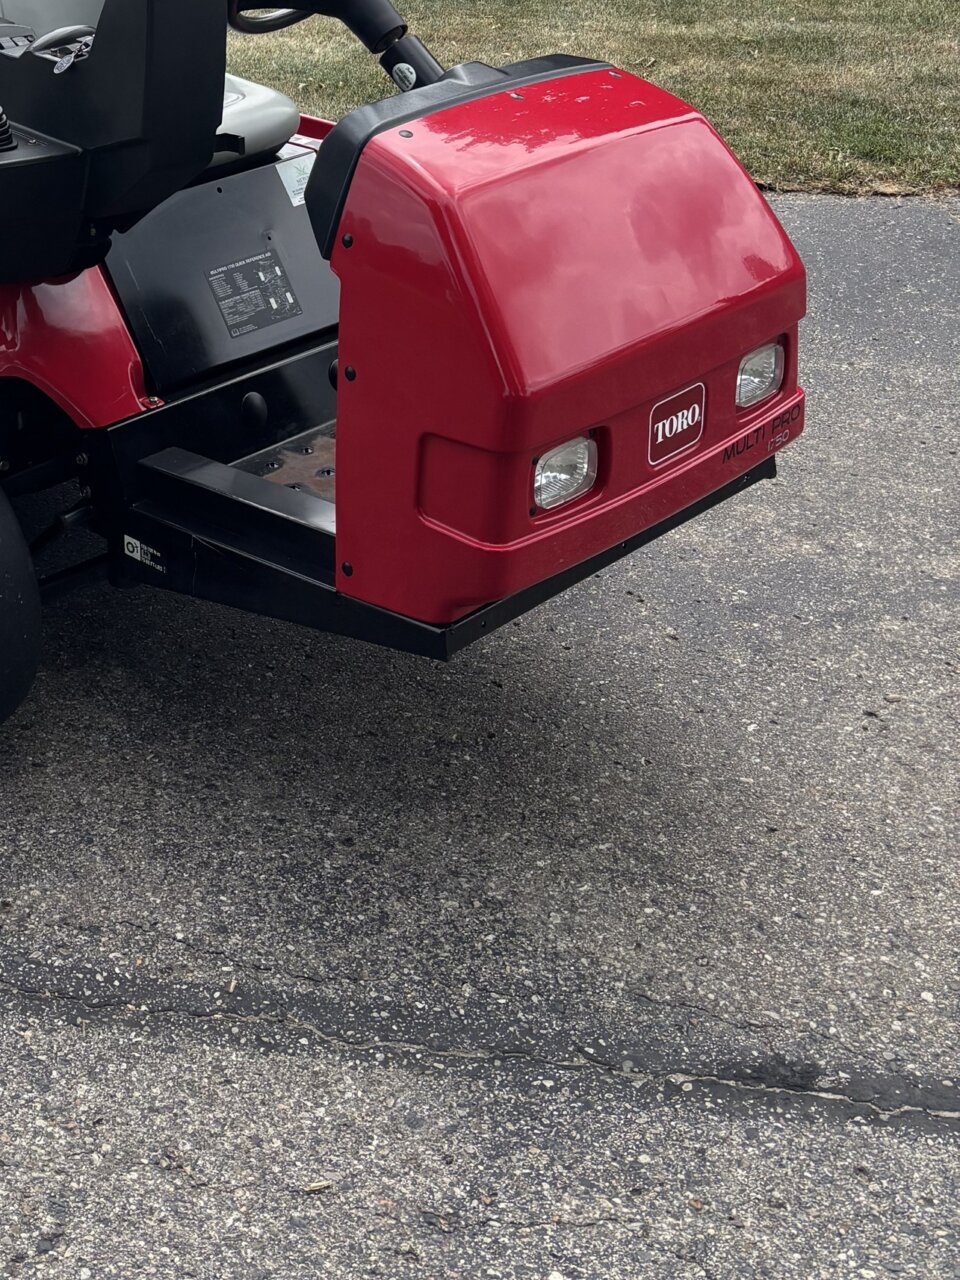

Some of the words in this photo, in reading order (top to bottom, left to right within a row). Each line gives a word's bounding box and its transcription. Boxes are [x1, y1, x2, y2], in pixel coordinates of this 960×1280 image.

[654, 403, 700, 445] TORO
[722, 426, 766, 464] MULTI
[771, 404, 800, 435] PRO
[767, 431, 790, 452] 1750
